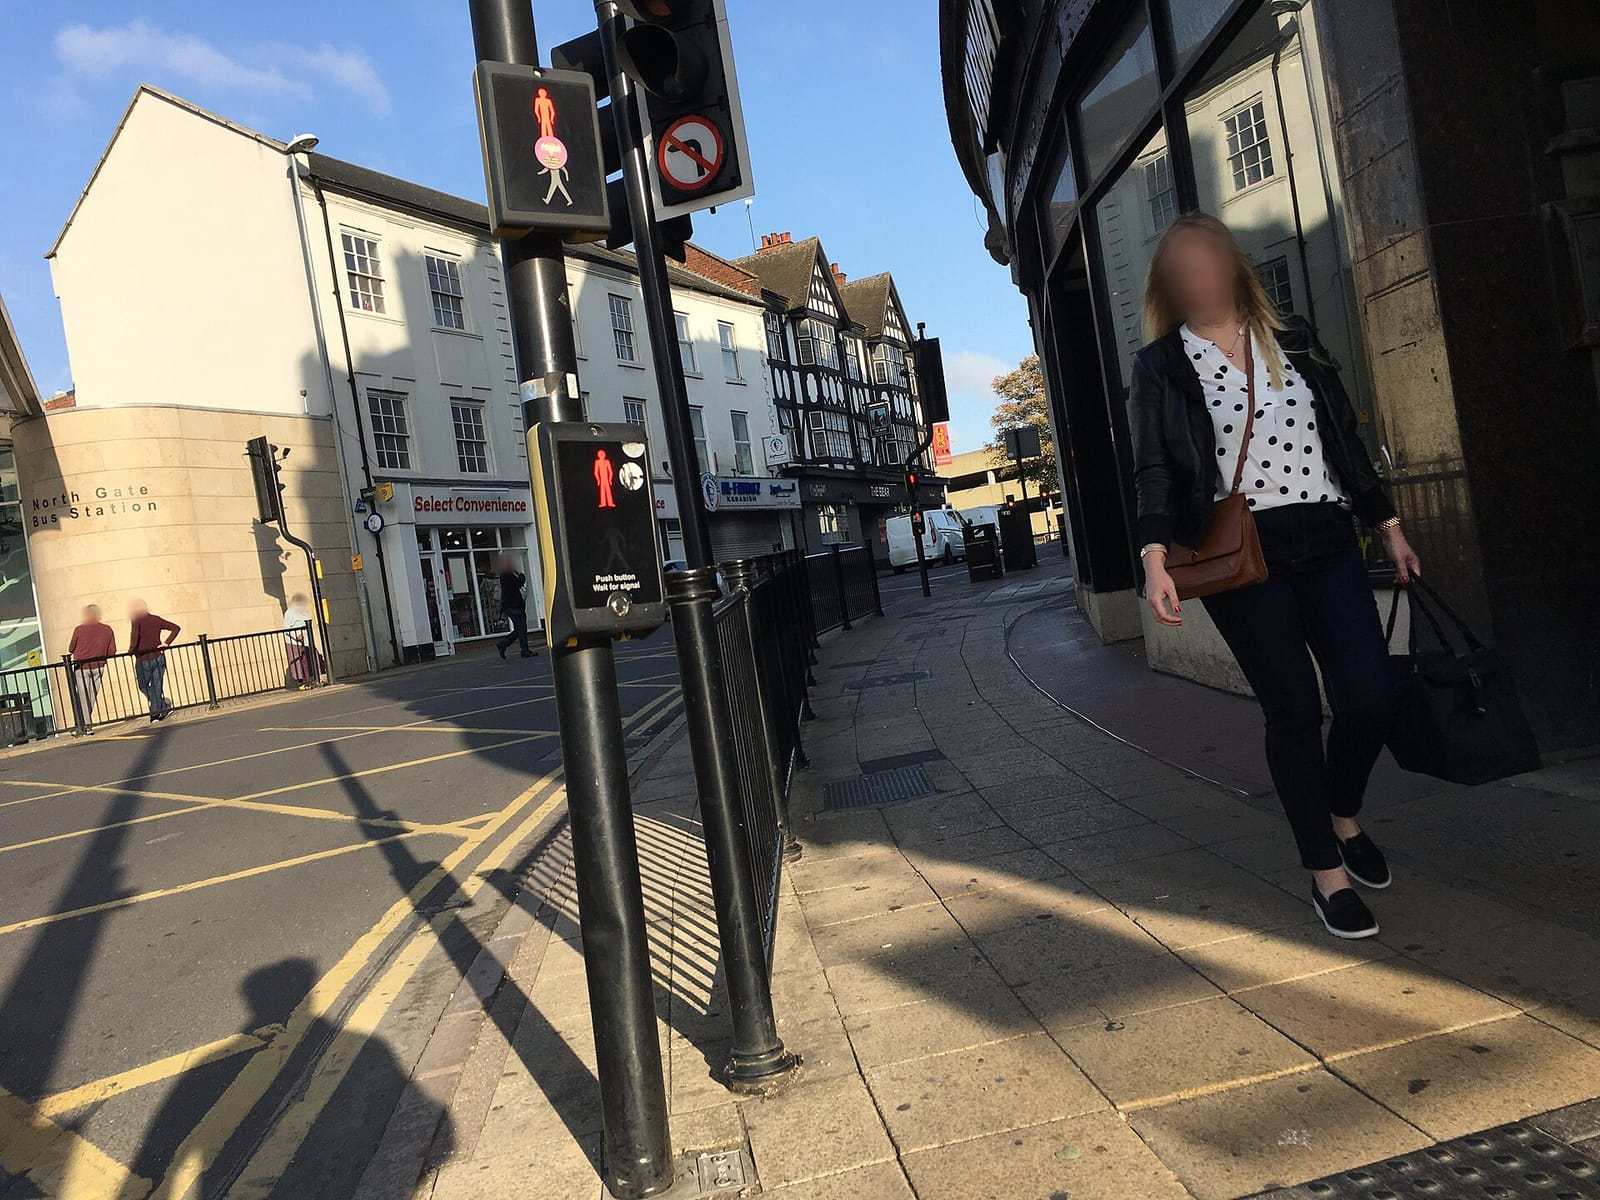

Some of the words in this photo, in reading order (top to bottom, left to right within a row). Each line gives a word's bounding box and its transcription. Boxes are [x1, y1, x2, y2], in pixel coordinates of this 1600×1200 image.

[32, 492, 79, 511] North
[95, 486, 148, 498] Gate
[414, 495, 453, 512] Select
[455, 496, 526, 512] Convenience
[32, 513, 57, 527] Bus
[69, 501, 157, 519] Station
[592, 583, 608, 592] Wait
[609, 582, 619, 591] for
[620, 580, 641, 591] signal
[595, 574, 613, 583] Push
[613, 573, 636, 582] button
